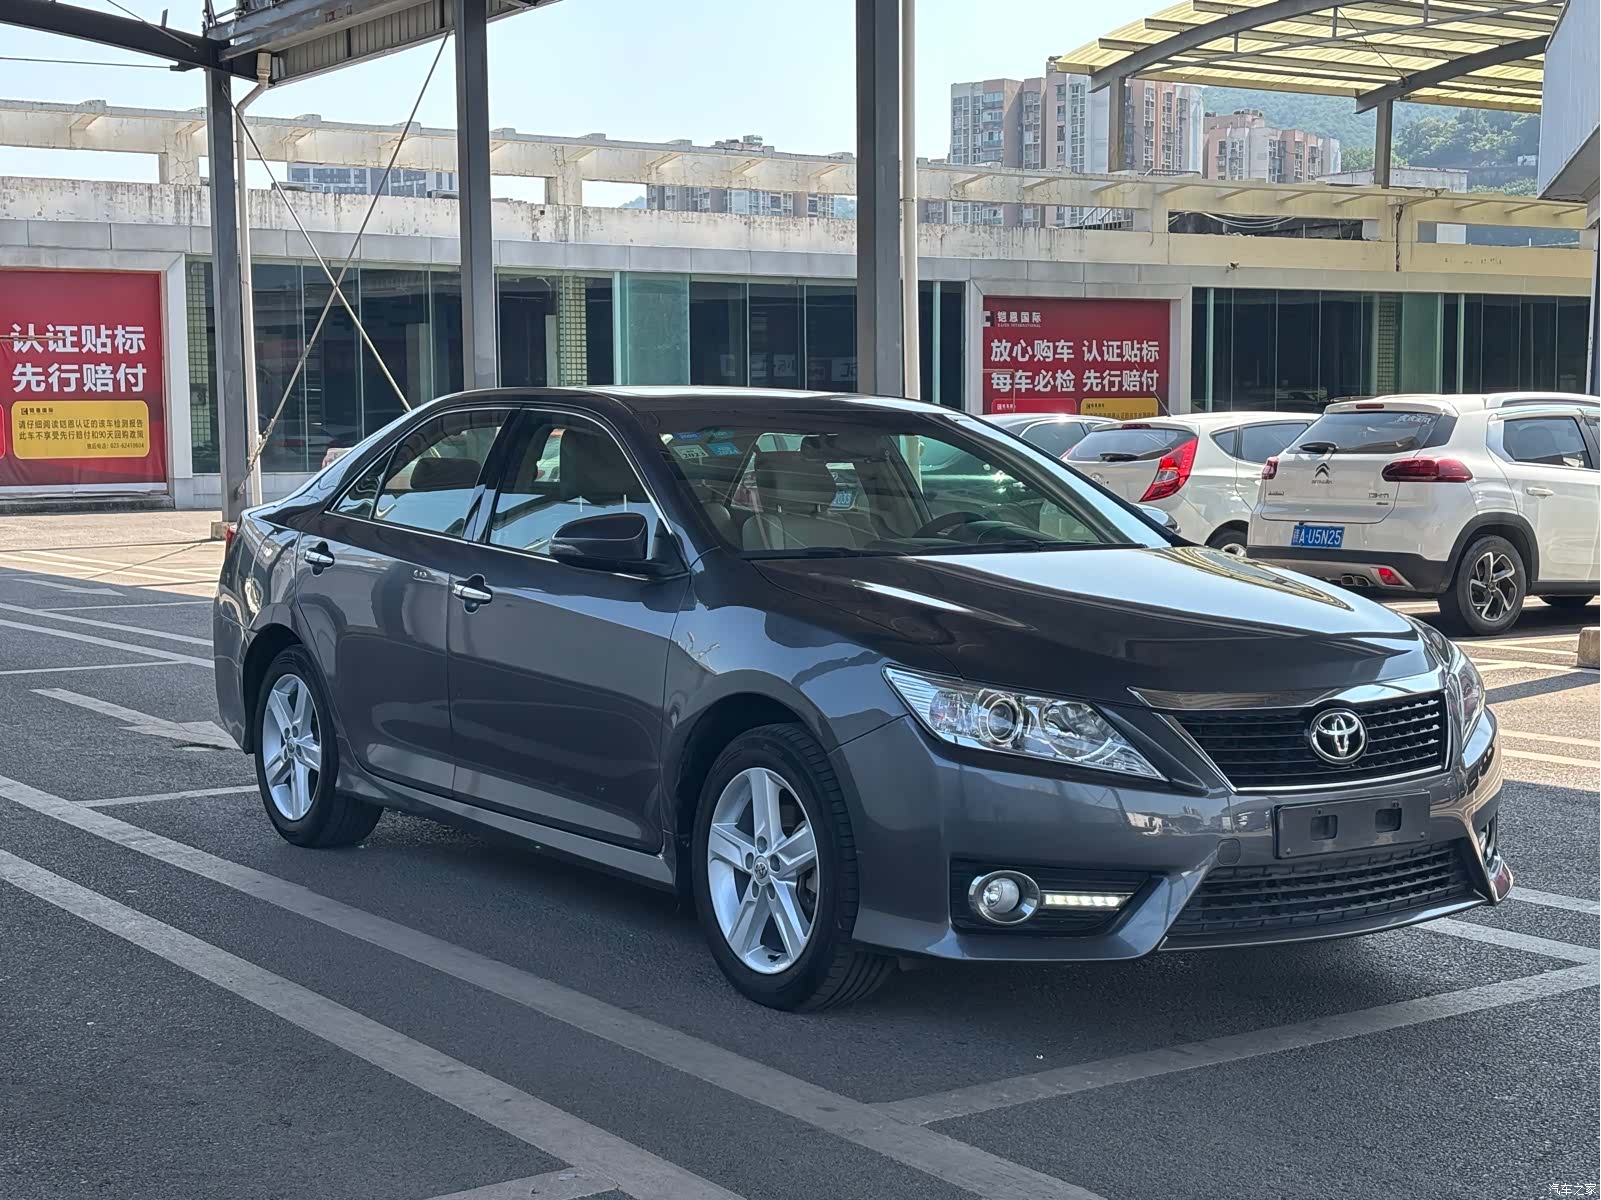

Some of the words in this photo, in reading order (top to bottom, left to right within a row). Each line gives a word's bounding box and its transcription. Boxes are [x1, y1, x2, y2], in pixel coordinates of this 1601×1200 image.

[997, 311, 1041, 323] 铠恩国际
[10, 323, 146, 354] 认证贴标
[990, 338, 1075, 363] 放心购车
[1082, 340, 1160, 363] 认证贴标
[12, 363, 147, 393] 先行赔付
[991, 369, 1076, 392] 每车必检
[1082, 369, 1159, 392] 先行赔付
